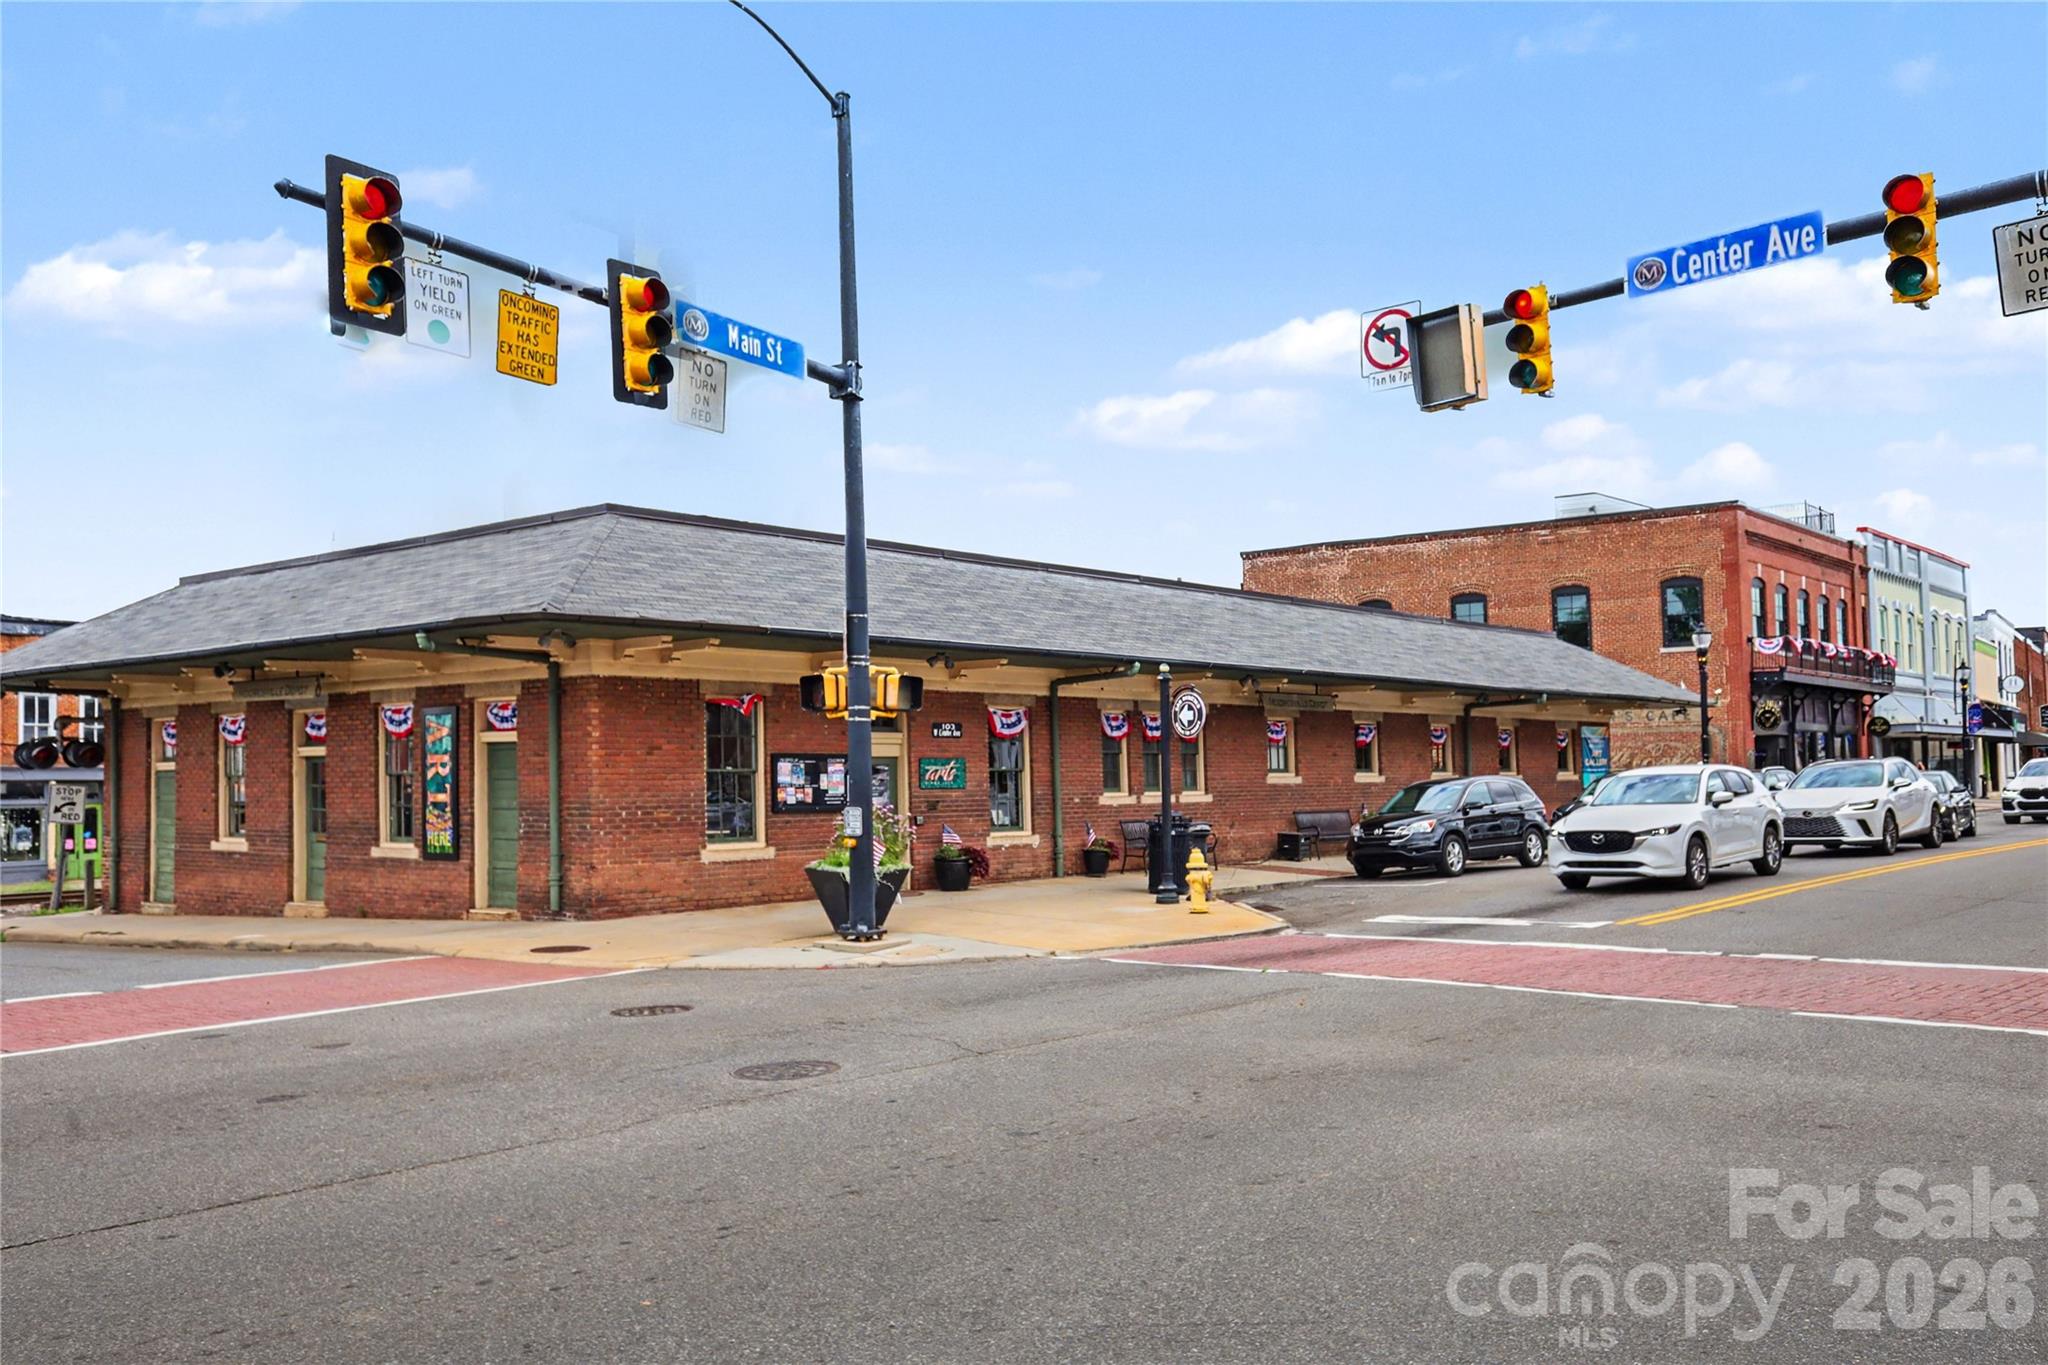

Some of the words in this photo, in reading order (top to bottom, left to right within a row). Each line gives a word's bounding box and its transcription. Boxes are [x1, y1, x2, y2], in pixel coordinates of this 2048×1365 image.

[1670, 238, 1754, 286] Center
[1765, 223, 1816, 265] Ave
[2013, 247, 2048, 267] TUR
[410, 266, 433, 281] LEFT
[438, 273, 463, 289] TURN
[420, 283, 456, 304] YIELD
[2025, 285, 2048, 304] RE
[414, 299, 428, 312] ON
[431, 305, 462, 321] GREEN
[501, 293, 557, 321] ONCOMING
[506, 310, 551, 335] TRAFFIC
[516, 330, 539, 347] HAS
[727, 323, 761, 358] Main
[766, 337, 783, 366] St
[499, 340, 556, 367] EXTENDED
[509, 359, 545, 380] GREEN
[692, 360, 714, 378] NO
[688, 376, 717, 394] TURN
[1372, 375, 1387, 387] 7am
[1389, 373, 1396, 383] to
[694, 393, 710, 407] ON
[691, 407, 712, 423] RED
[426, 719, 451, 813] ART
[924, 760, 959, 781] arts
[56, 788, 81, 796] STOP
